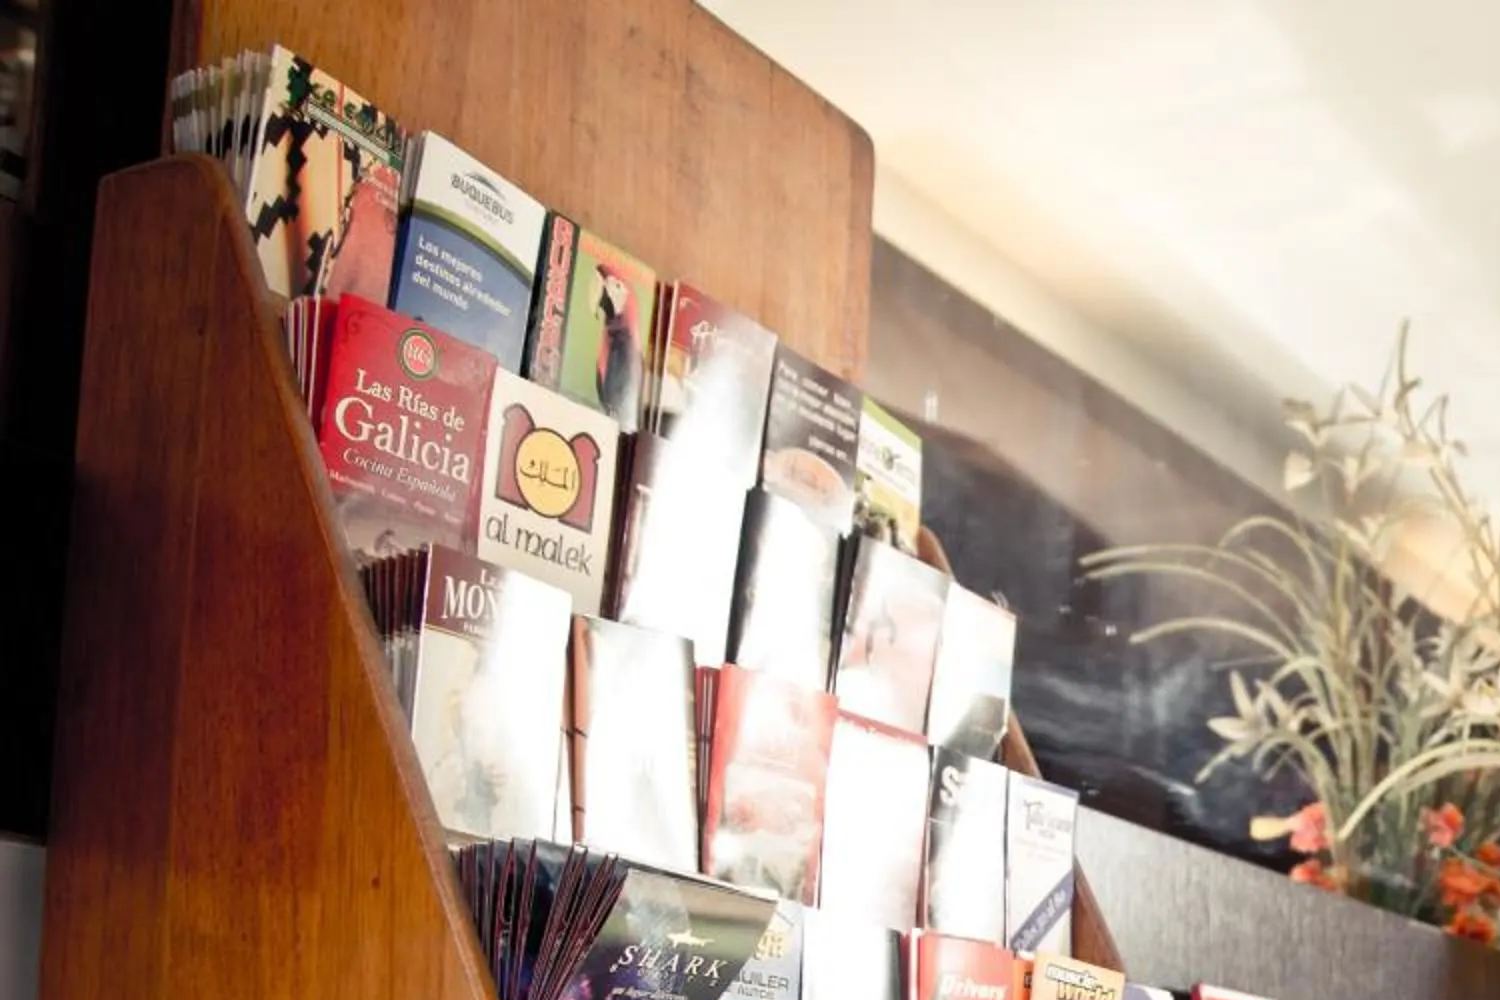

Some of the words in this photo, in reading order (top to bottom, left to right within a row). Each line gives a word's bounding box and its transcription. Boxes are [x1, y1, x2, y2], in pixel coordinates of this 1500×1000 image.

[451, 173, 514, 224] BUQUEBUS
[354, 368, 392, 402] Las
[397, 384, 439, 421] Rías
[443, 406, 465, 432] de
[335, 396, 470, 484] Galicia
[343, 447, 393, 480] Cocina
[485, 513, 509, 545] al
[514, 528, 593, 576] malek
[618, 945, 728, 979] SHARK
